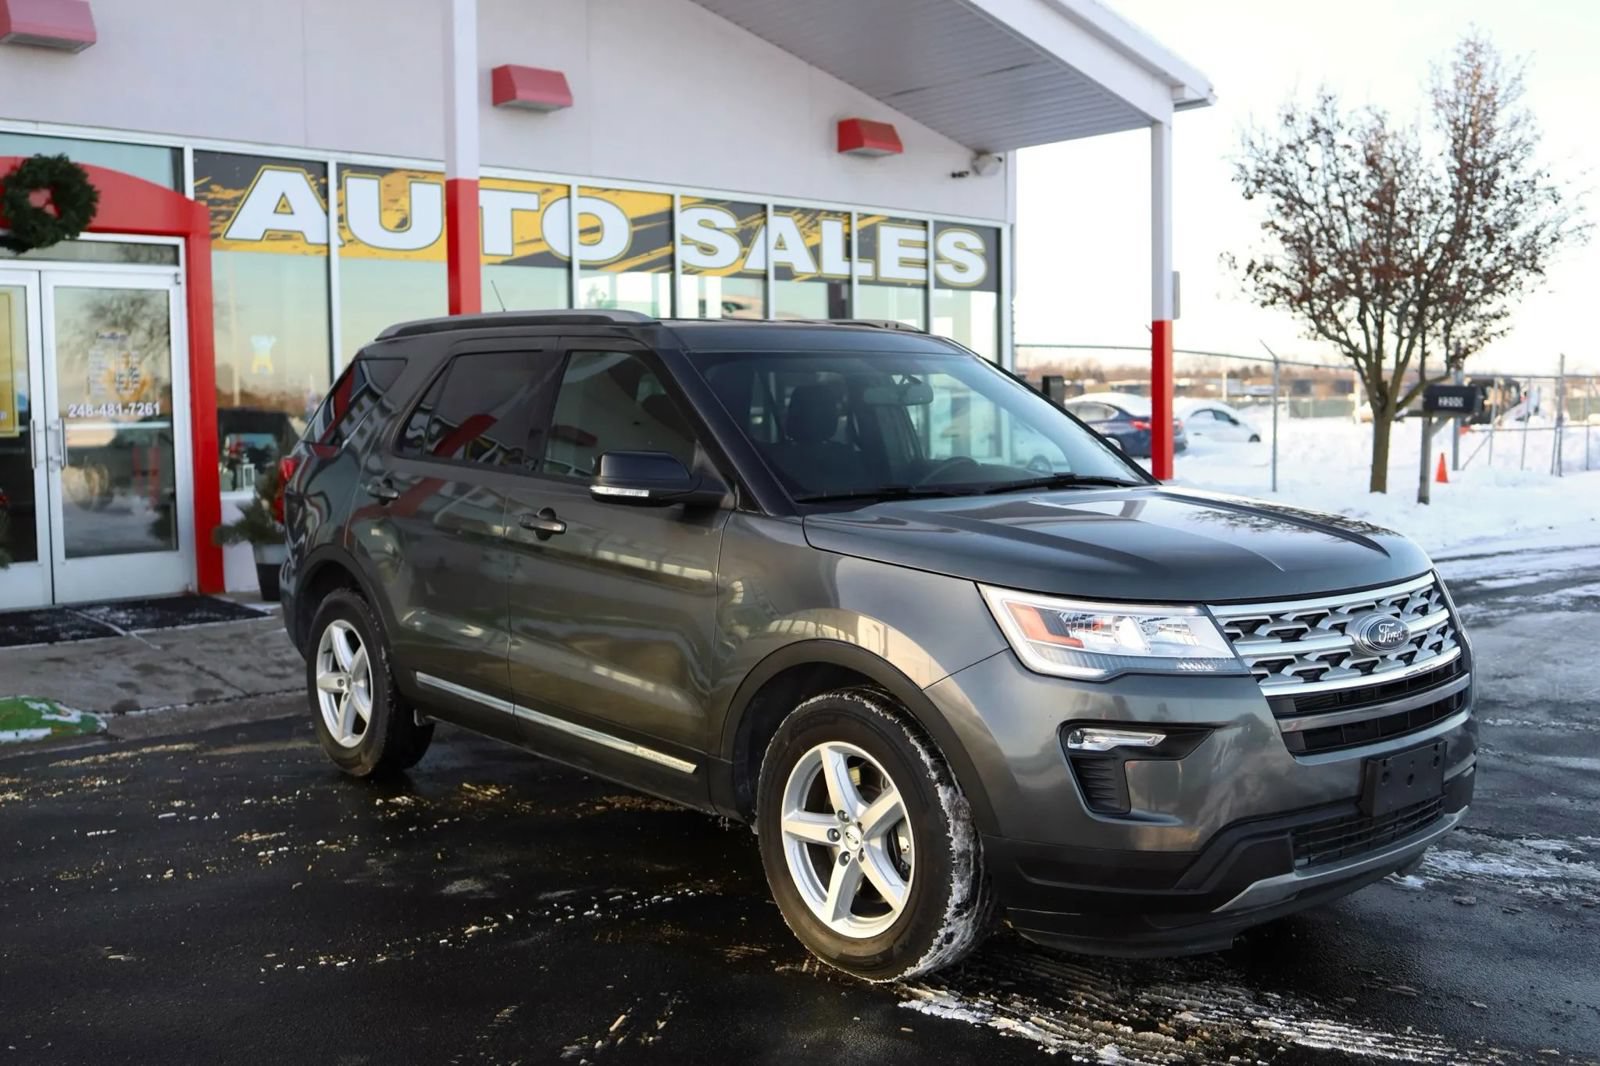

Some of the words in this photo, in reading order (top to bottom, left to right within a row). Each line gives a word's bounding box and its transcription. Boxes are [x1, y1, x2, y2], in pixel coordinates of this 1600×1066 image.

[222, 165, 632, 263] AUTO
[680, 205, 988, 287] SALES
[68, 402, 161, 418] 248-481-7261
[1378, 622, 1404, 643] Ford
